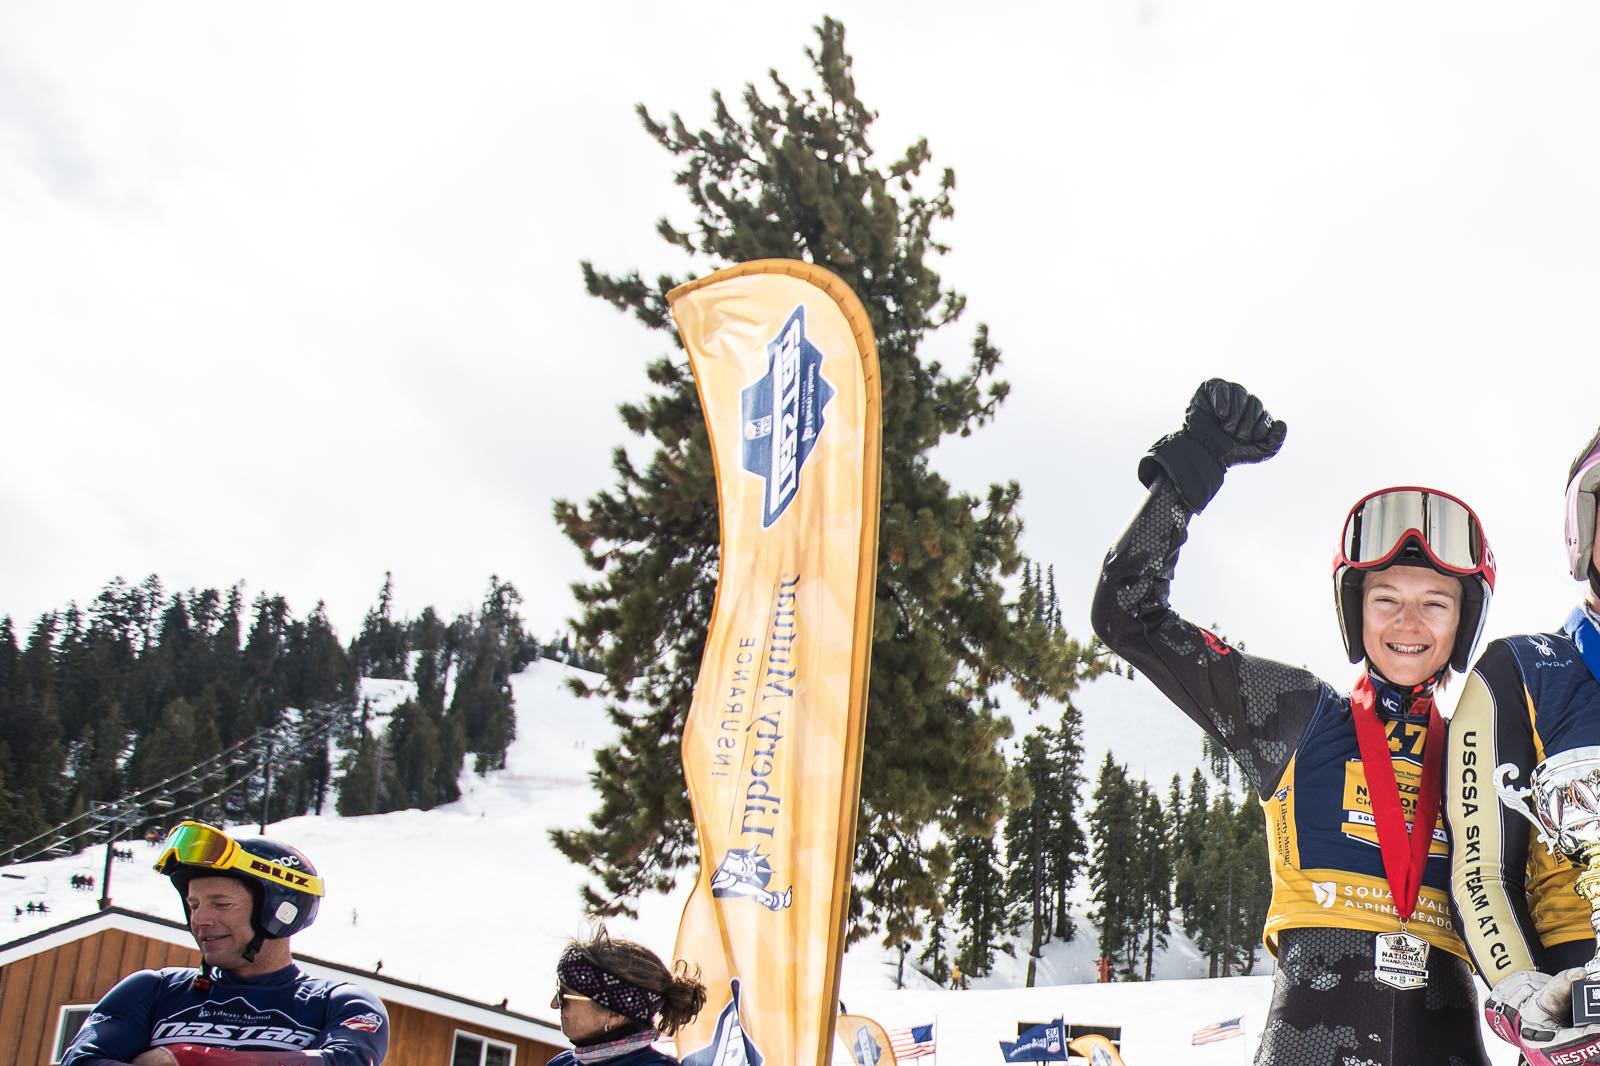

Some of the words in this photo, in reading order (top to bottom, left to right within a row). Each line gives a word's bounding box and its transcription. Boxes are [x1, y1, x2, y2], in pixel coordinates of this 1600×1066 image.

[1384, 720, 1428, 755] 47
[1461, 730, 1480, 819] USCSA
[1279, 802, 1289, 835] Liberty
[1357, 814, 1376, 822] SQU
[1465, 825, 1481, 864] SKI
[249, 859, 310, 888] BLIZ
[1343, 885, 1393, 899] SQUA
[1417, 895, 1451, 914] VALL
[1465, 865, 1489, 912] TEAM
[1410, 911, 1453, 930] MEADO
[1477, 914, 1500, 938] AT
[1381, 951, 1425, 963] NATIONAL
[1489, 941, 1512, 971] CU
